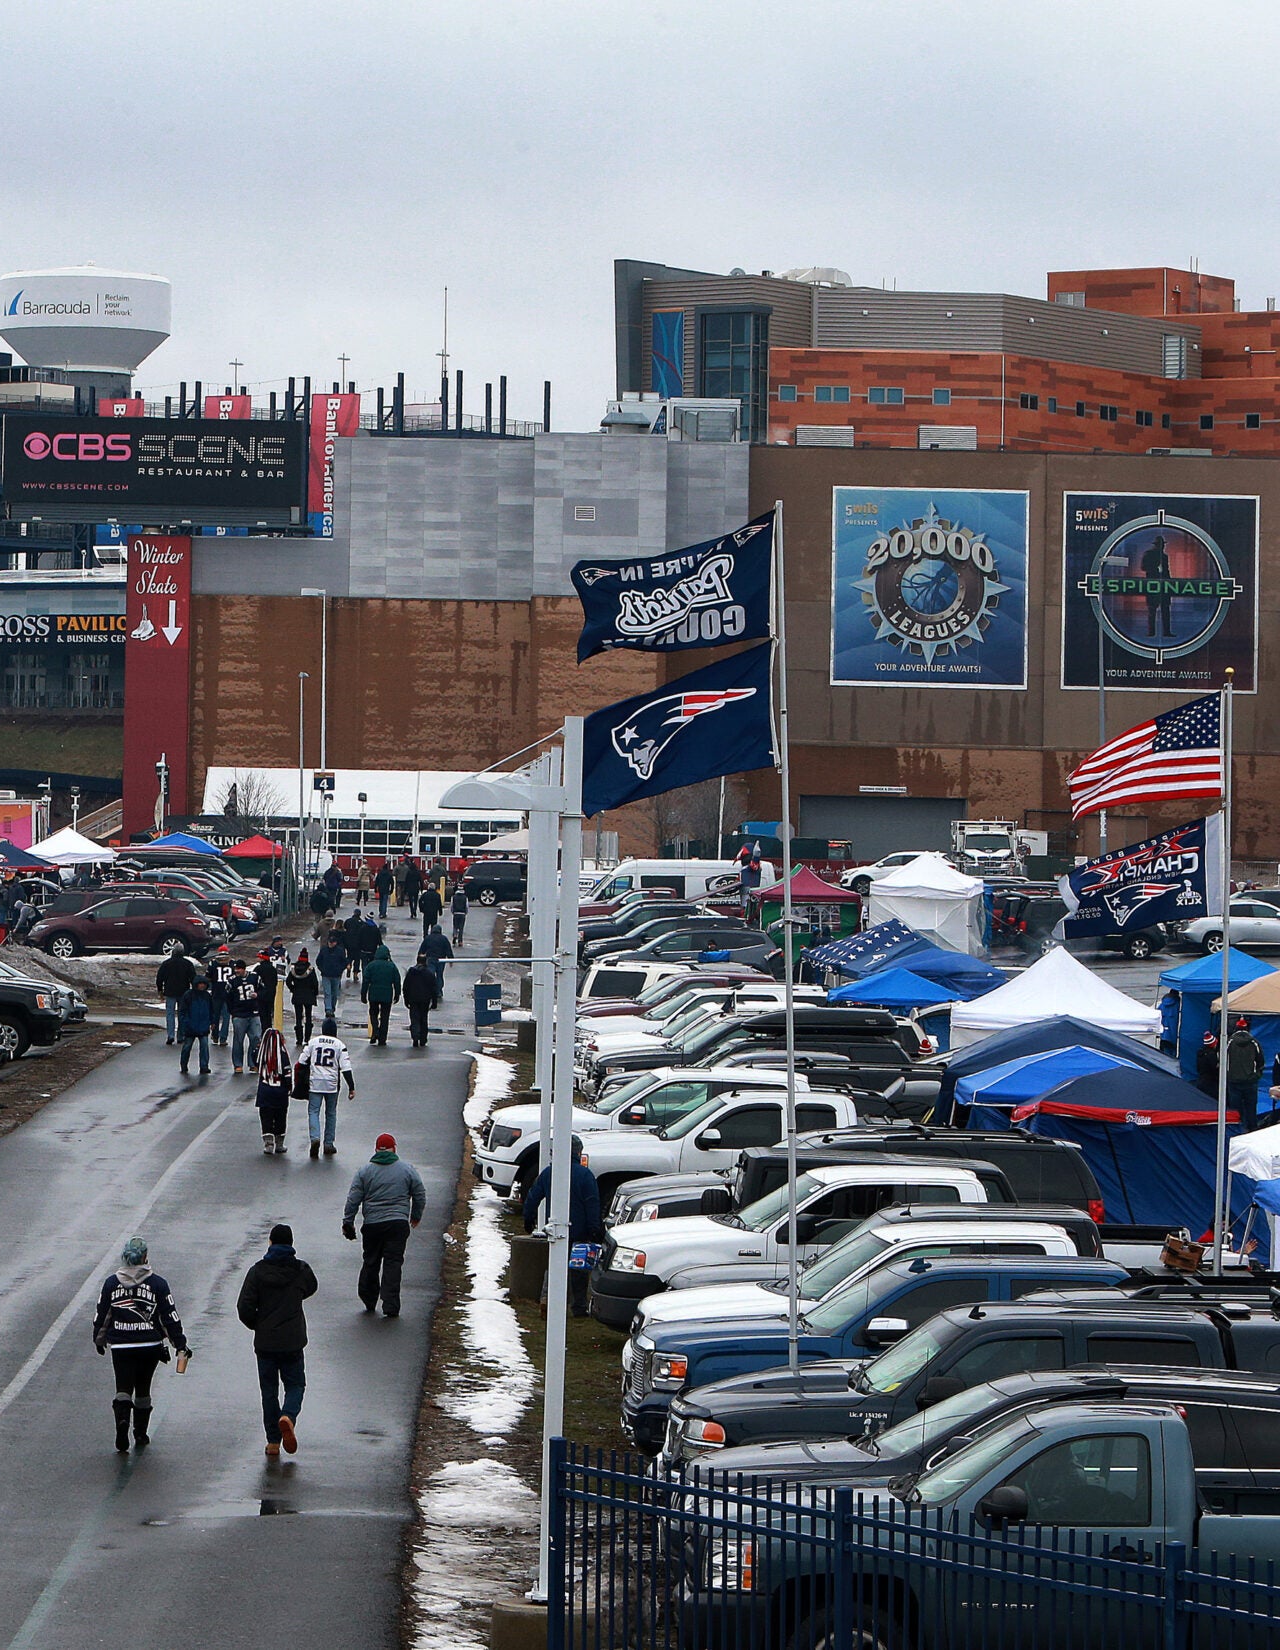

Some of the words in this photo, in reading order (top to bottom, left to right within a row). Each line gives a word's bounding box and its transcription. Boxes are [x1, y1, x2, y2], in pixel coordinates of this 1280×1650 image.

[104, 294, 130, 302] Reclaim
[22, 301, 91, 315] Barracuda
[53, 433, 131, 461] CBS
[138, 434, 286, 465] SCENE
[138, 467, 232, 478] RESTAURANT
[240, 469, 249, 478] &
[257, 470, 285, 478] BAR
[22, 481, 129, 491] WWW.CBSSCENE.COM
[134, 540, 185, 565] Winter
[866, 527, 994, 573] 20,000
[135, 566, 179, 595] Skate
[1091, 579, 1230, 595] ESPIONAGE
[56, 616, 126, 631] PAVILIO
[888, 609, 970, 639] LEAGUES
[67, 635, 108, 643] BUSINESS
[874, 663, 897, 671] YOUR
[900, 663, 946, 672] ADVENTURE
[948, 665, 982, 673] AWAITS!
[1105, 669, 1127, 678] YOUR
[1130, 670, 1177, 679] ADVENTURE
[1179, 671, 1212, 680] AWAITS!
[320, 779, 328, 789] 4
[216, 967, 232, 982] 12
[237, 984, 255, 1001] 12
[315, 1046, 336, 1067] 12
[137, 1288, 156, 1302] BOWL
